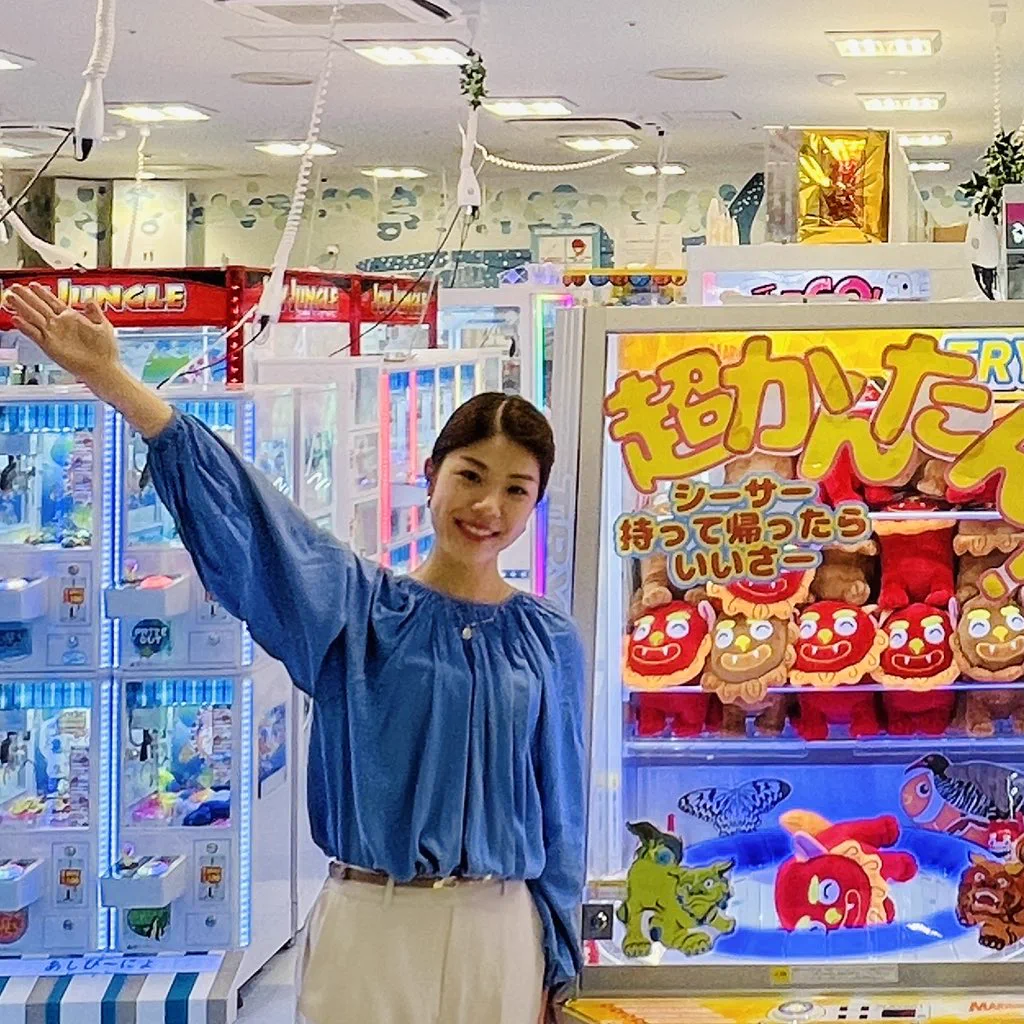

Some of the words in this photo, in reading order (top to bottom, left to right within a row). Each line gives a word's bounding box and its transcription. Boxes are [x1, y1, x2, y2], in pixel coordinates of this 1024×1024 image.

[674, 479, 814, 513] シーサー
[620, 506, 868, 555] 持って帰ったら
[674, 544, 817, 582] いいさー
